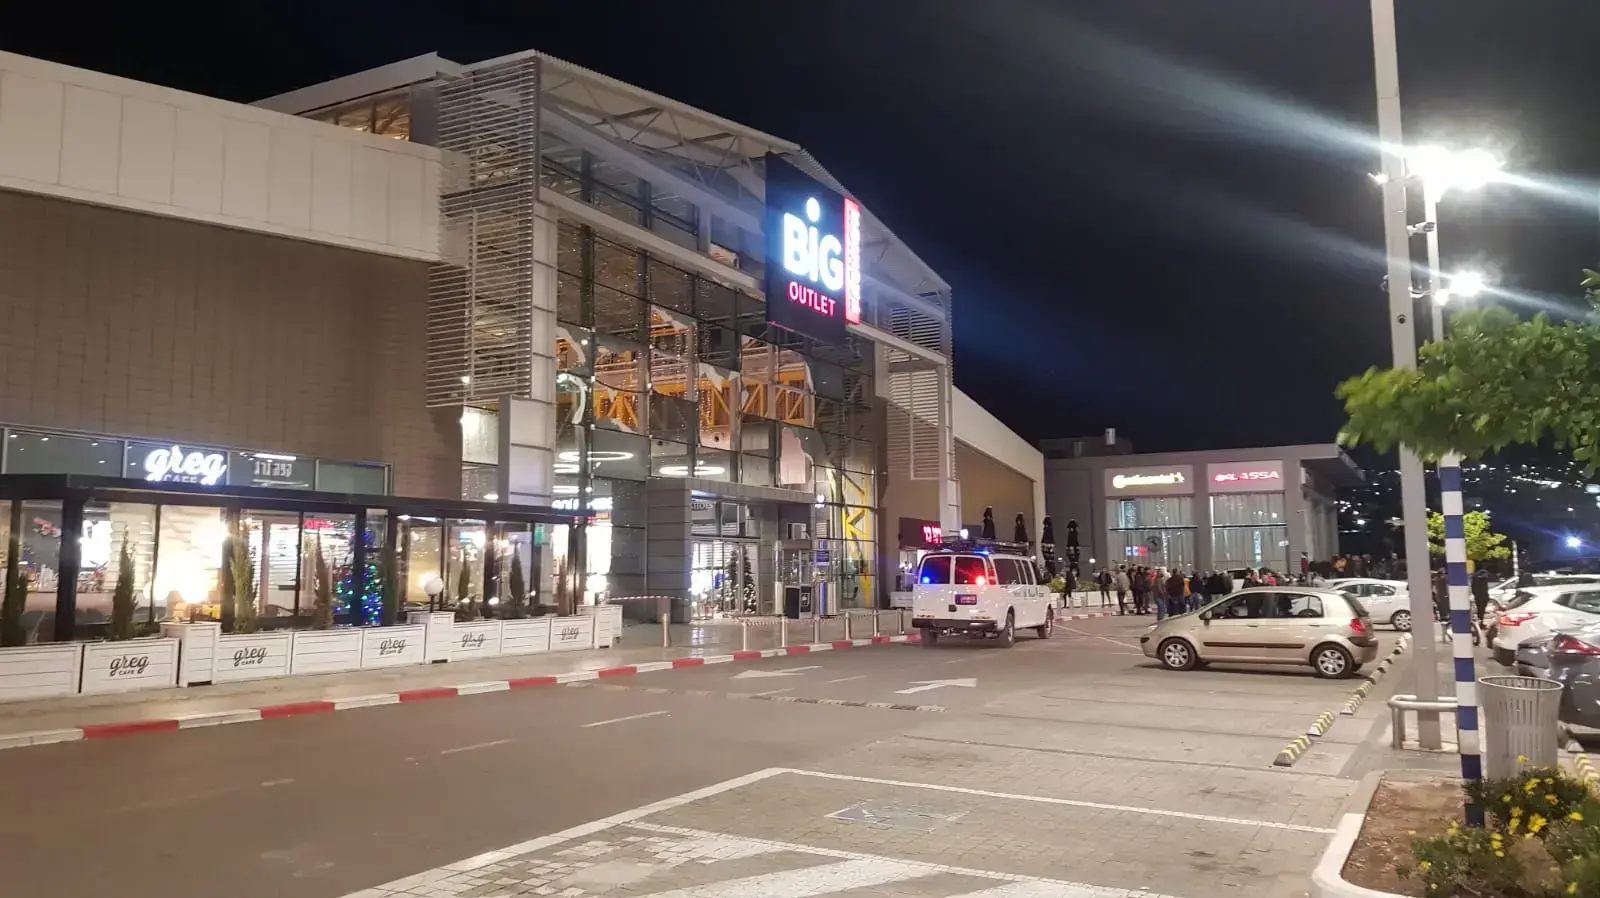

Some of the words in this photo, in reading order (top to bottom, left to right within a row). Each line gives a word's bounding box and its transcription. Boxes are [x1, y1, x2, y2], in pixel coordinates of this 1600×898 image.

[788, 280, 836, 317] OUTLET
[144, 445, 227, 486] greg
[109, 655, 150, 677] greg
[233, 646, 268, 667] greg
